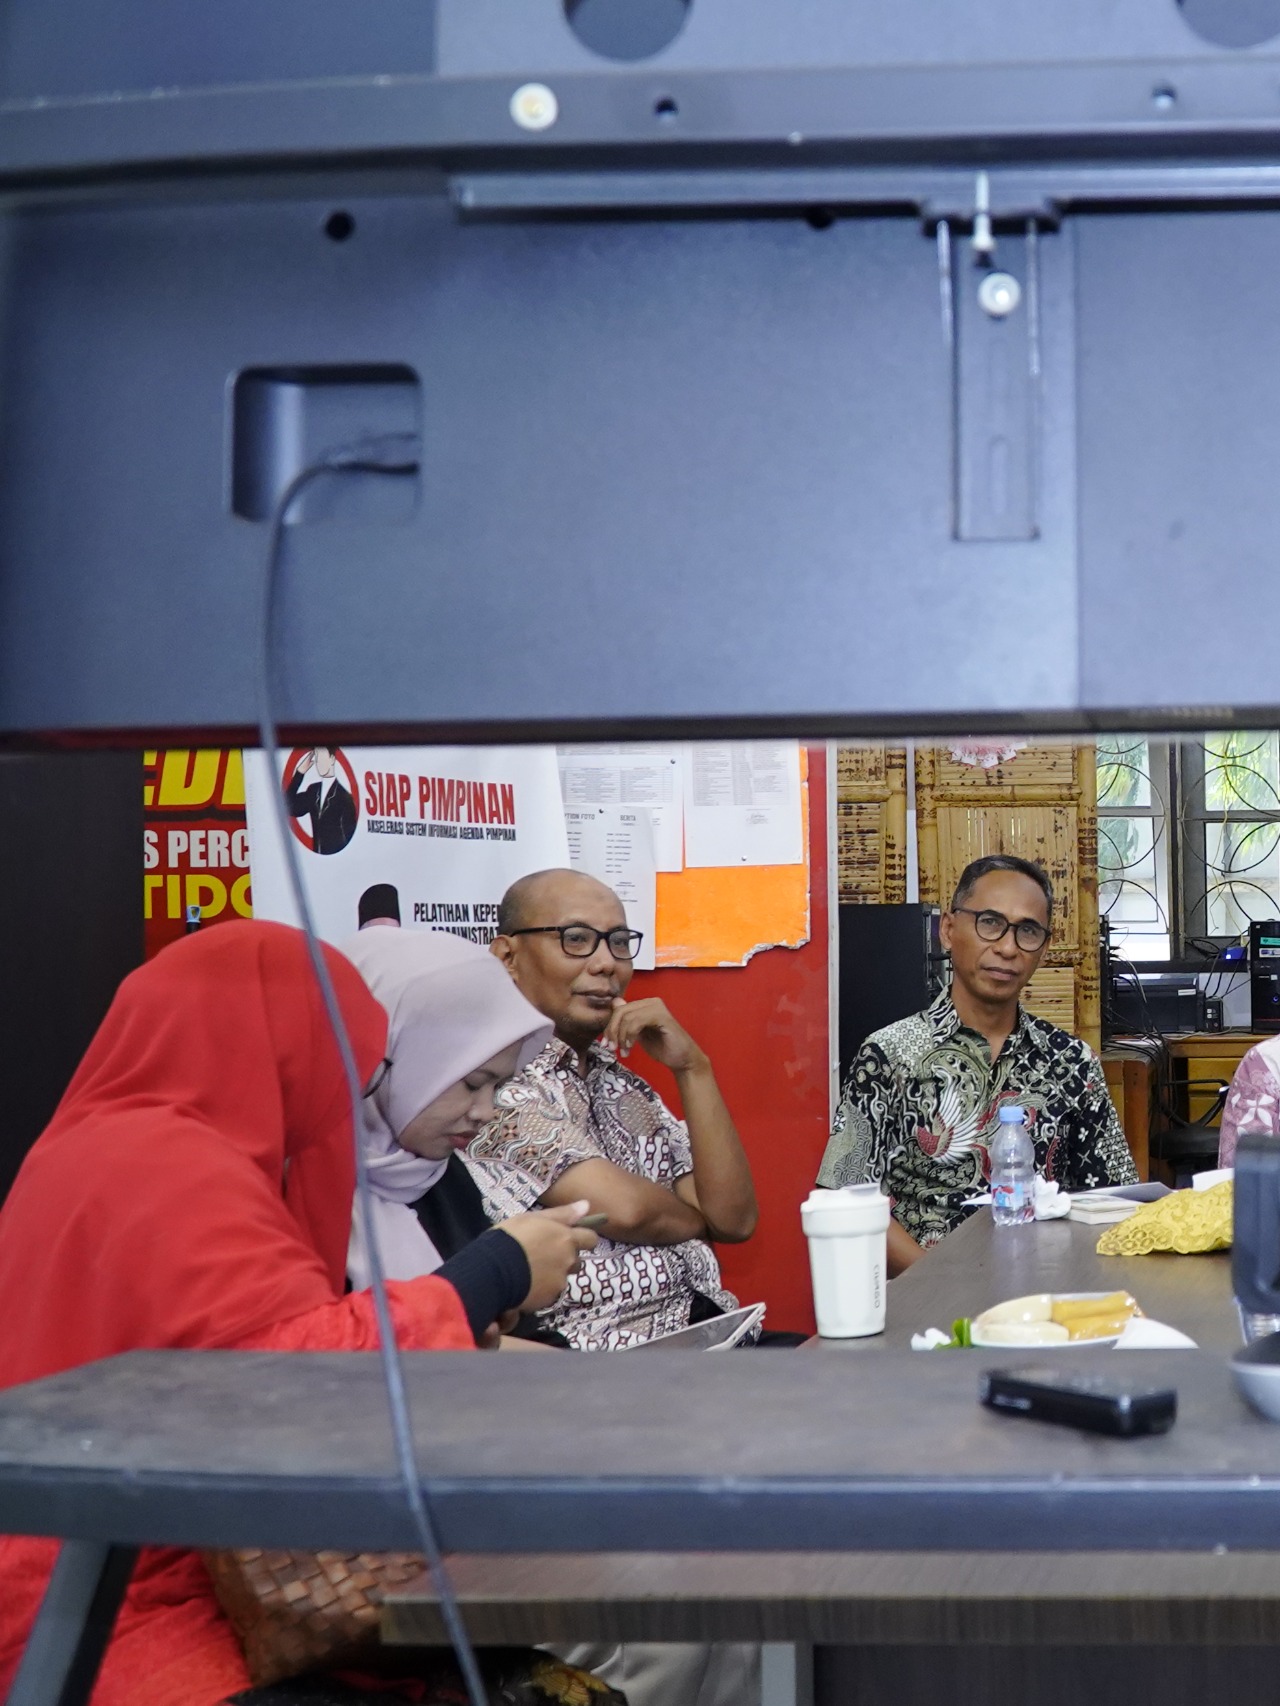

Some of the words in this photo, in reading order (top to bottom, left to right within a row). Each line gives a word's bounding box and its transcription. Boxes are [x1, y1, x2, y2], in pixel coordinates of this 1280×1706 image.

[364, 770, 411, 818] SIAP
[418, 776, 516, 825] PIMPINAN
[367, 819, 404, 835] AKSELERASI
[405, 822, 427, 837] SISTEM
[428, 824, 458, 839] INFORMASI
[459, 826, 485, 840] AGENDA
[486, 827, 517, 842] PIMPINAN
[167, 829, 251, 869] PERC
[413, 903, 470, 923] PELATIHAN
